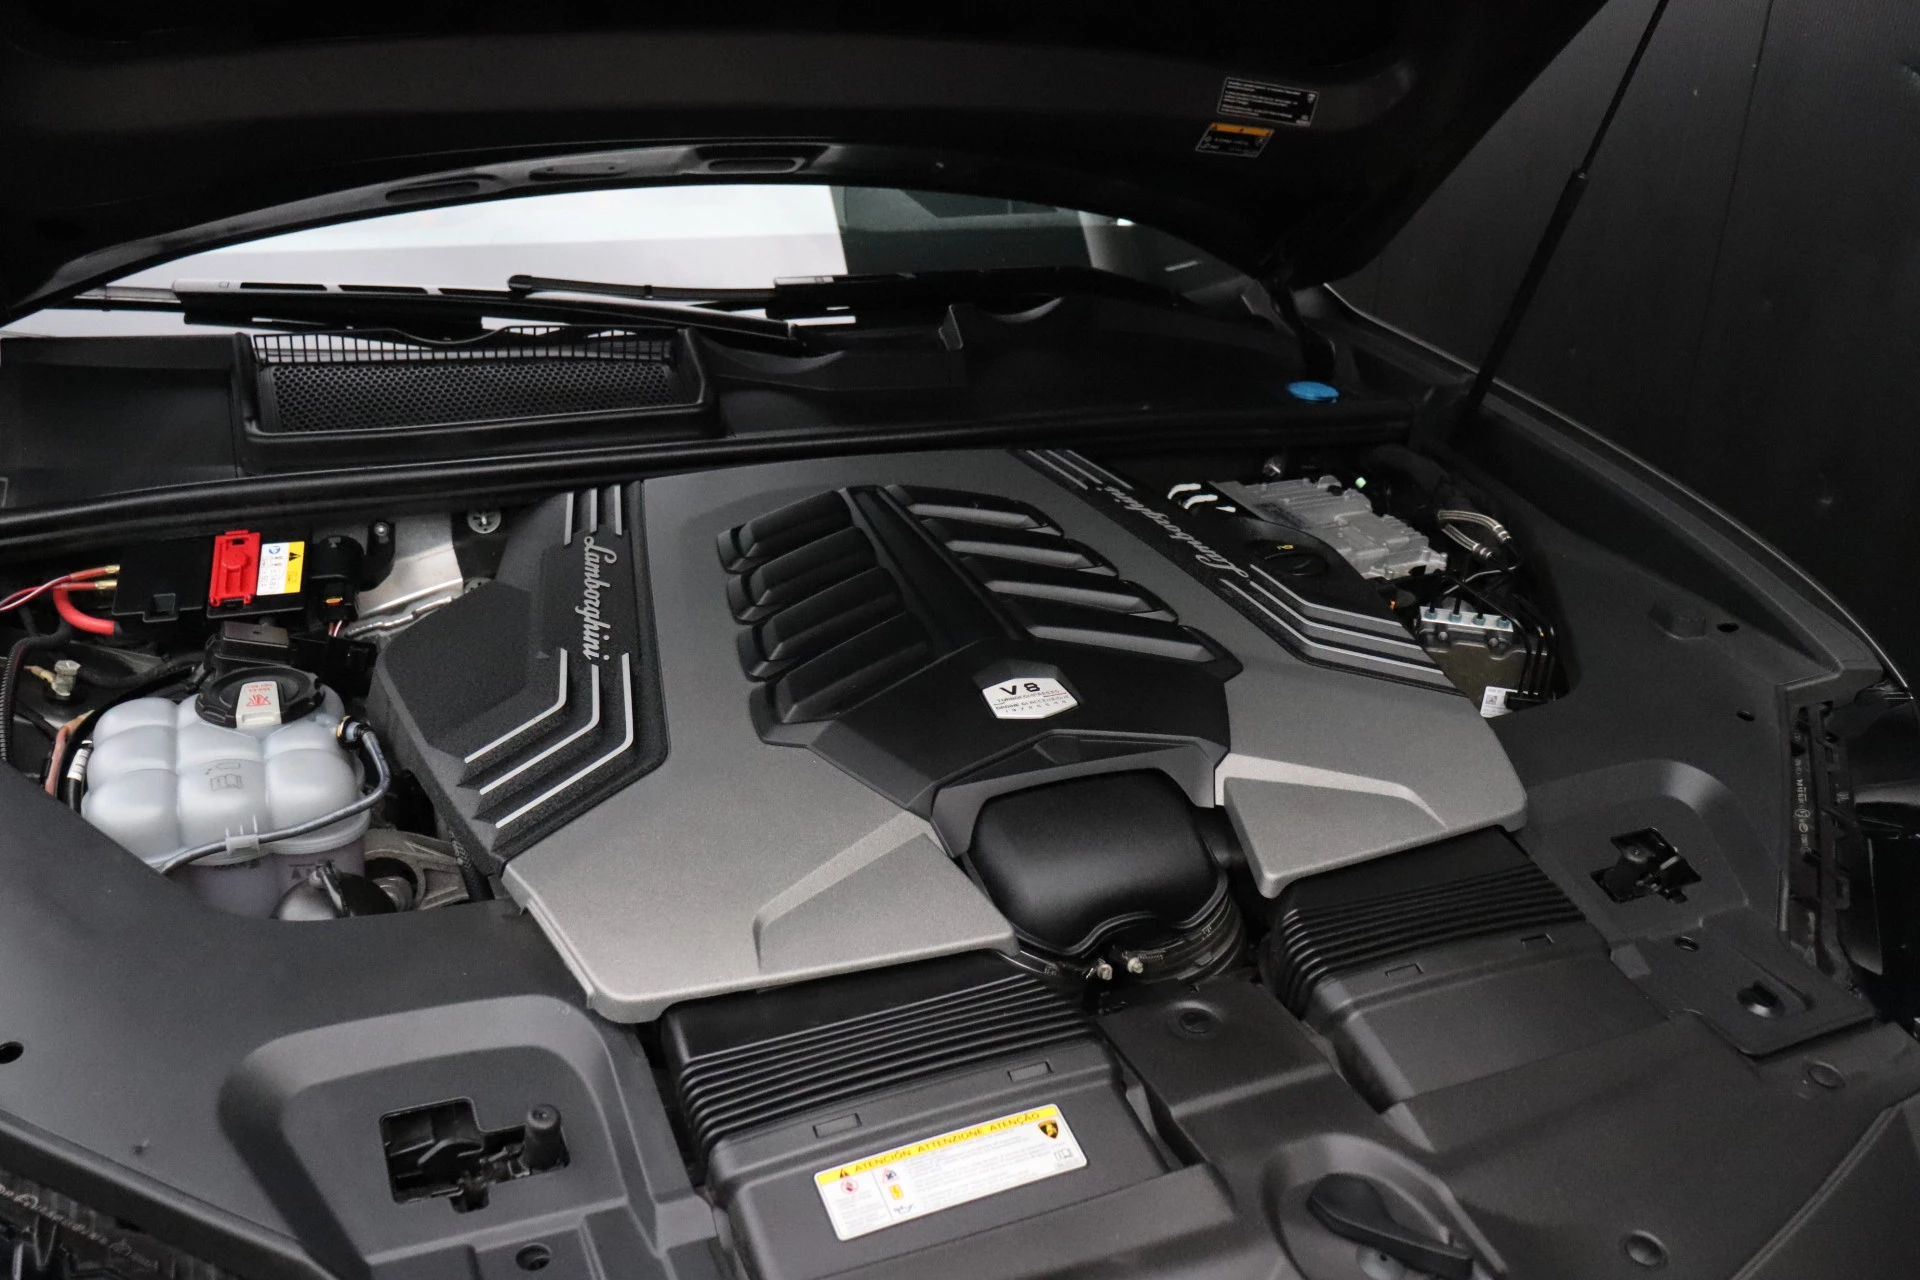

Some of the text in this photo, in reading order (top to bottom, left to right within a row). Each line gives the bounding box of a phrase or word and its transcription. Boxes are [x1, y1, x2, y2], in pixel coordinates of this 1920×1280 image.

[1096, 486, 1249, 578] Lamborghini
[574, 536, 617, 661] Lamborghini
[854, 1112, 1040, 1173] ATENCIÓN ATTENZIONE ATENÇÃO
